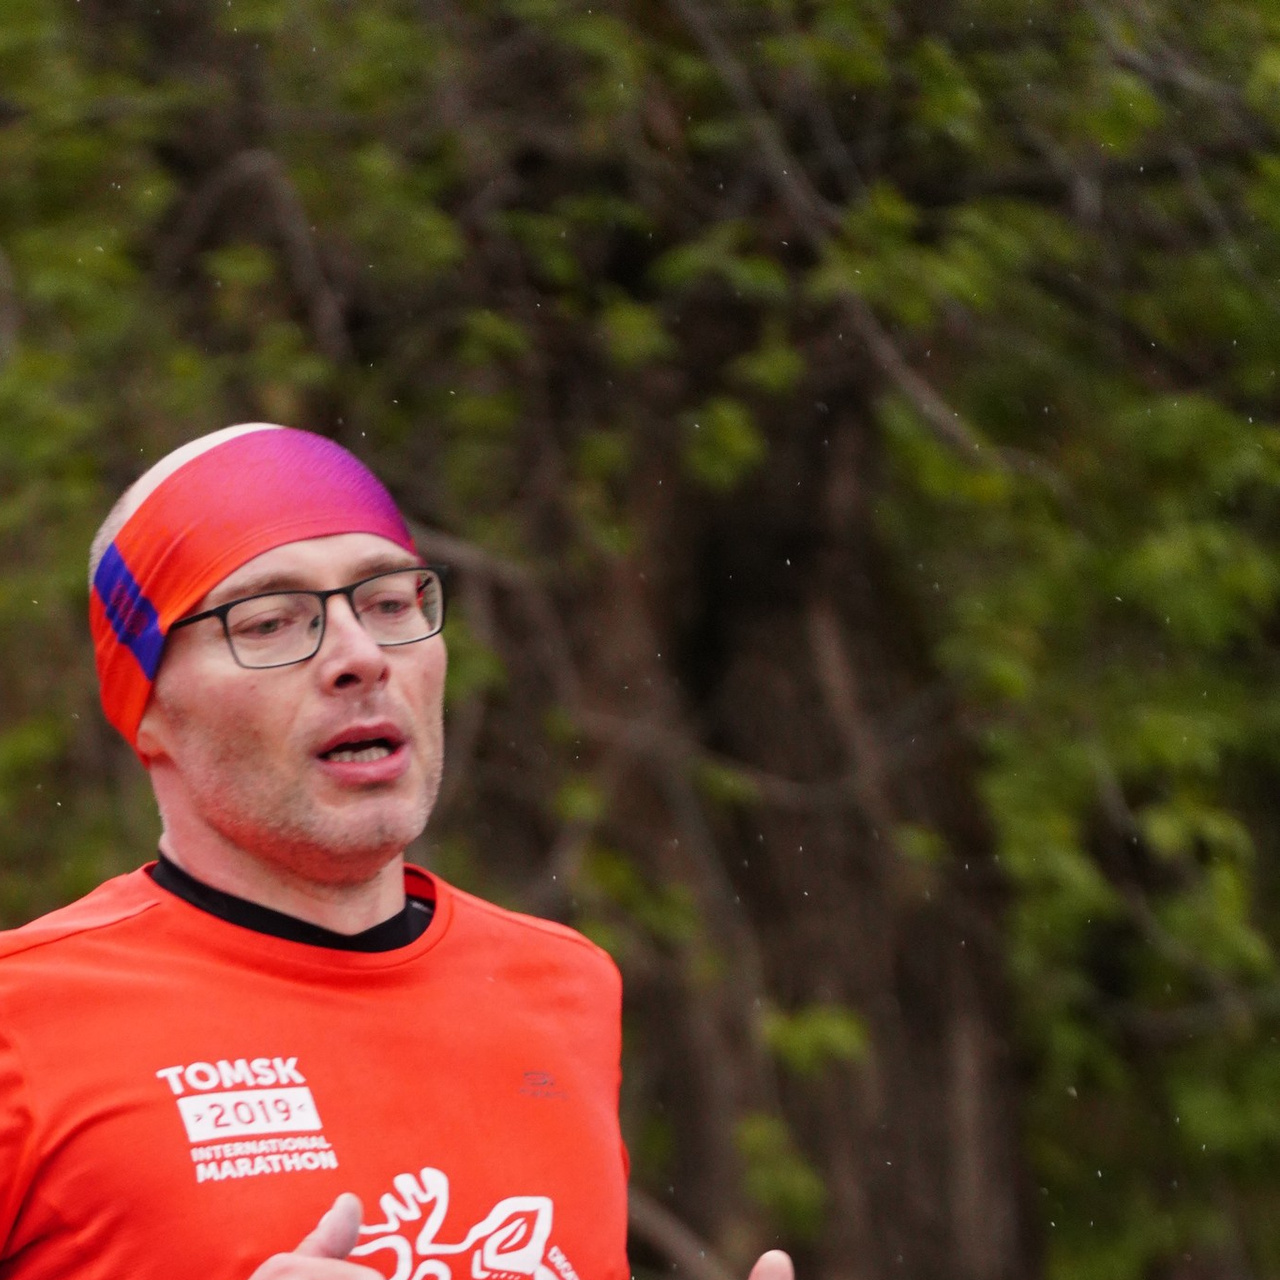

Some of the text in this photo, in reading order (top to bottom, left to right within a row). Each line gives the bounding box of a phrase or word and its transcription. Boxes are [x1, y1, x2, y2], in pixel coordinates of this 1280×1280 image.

[155, 1057, 307, 1096] TOMSK
[207, 1097, 293, 1129] 2019
[190, 1134, 333, 1163] INTERNATIONAL
[195, 1149, 339, 1184] MARATHON
